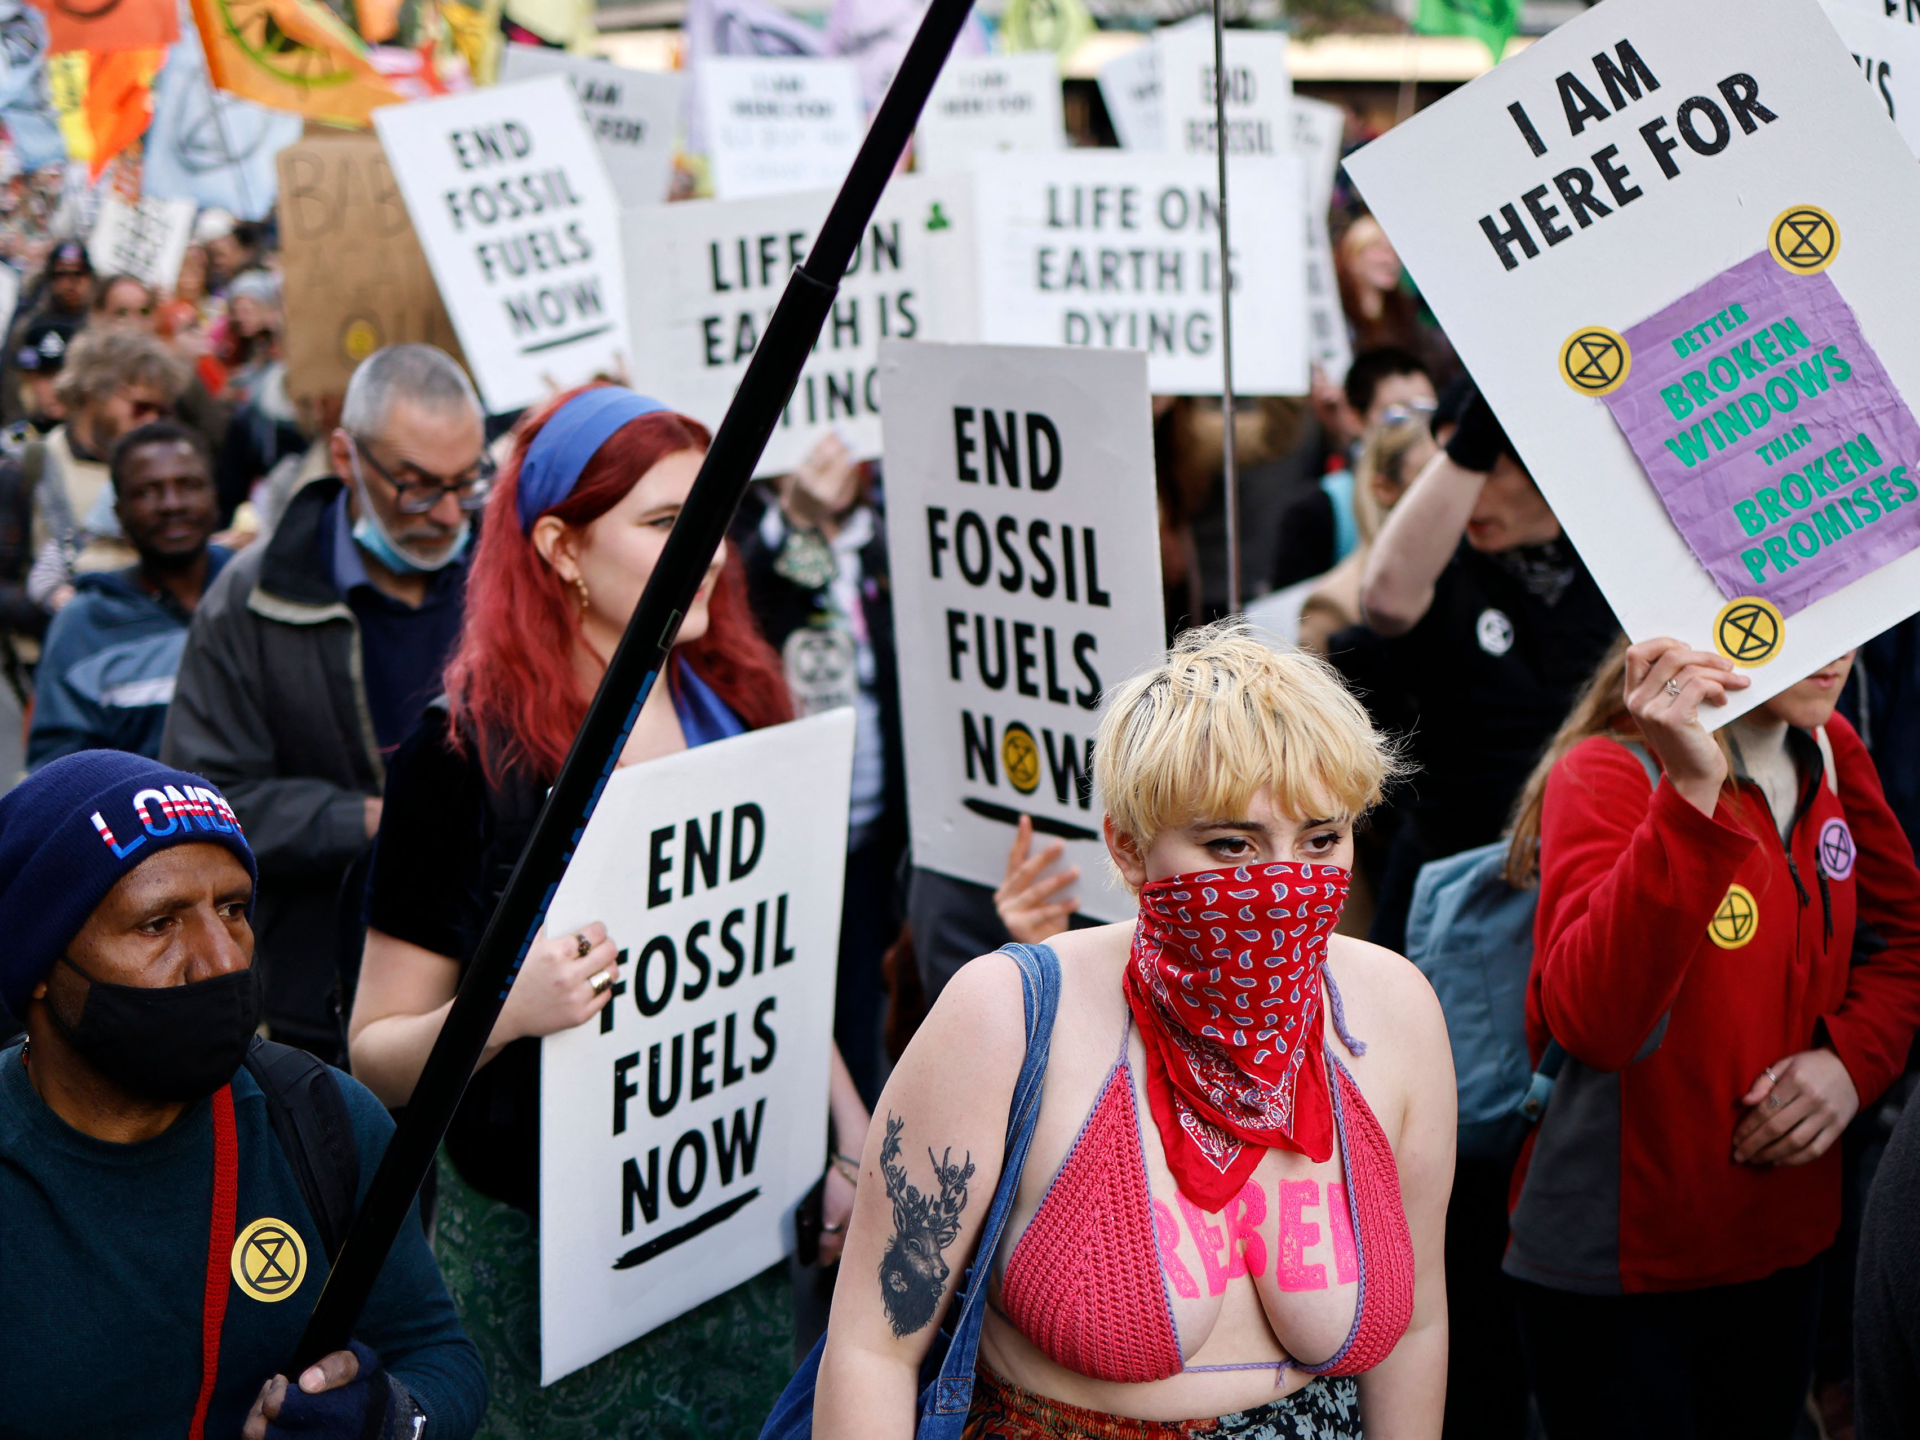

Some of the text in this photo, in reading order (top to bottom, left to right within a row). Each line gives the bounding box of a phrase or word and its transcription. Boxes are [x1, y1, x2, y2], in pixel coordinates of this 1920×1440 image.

[451, 122, 531, 169] END
[1507, 38, 1661, 158] I AM
[446, 168, 581, 230] FOSSIL
[1048, 186, 1137, 230] LIFE
[1478, 143, 1643, 272] HERE
[1639, 73, 1779, 180] FOR
[477, 222, 593, 282] FUELS
[1038, 248, 1182, 292] EARTH
[504, 276, 604, 337] NOW
[702, 290, 918, 367] EAH IS
[1064, 311, 1214, 355] DYING
[1671, 302, 1749, 359] BETTER
[1659, 317, 1811, 421] BROKEN
[1664, 345, 1851, 468] WINDOWS
[953, 406, 1062, 491] END
[1733, 433, 1883, 537] BROKEN
[1755, 423, 1812, 466] THAN
[926, 506, 1111, 607] FOSSIL
[1741, 465, 1919, 584] PROMISES
[946, 609, 1101, 711] FUELS
[647, 802, 765, 910] END
[600, 893, 796, 1036] FOSSIL
[613, 997, 777, 1136] FUELS
[621, 1097, 767, 1236] NOW
